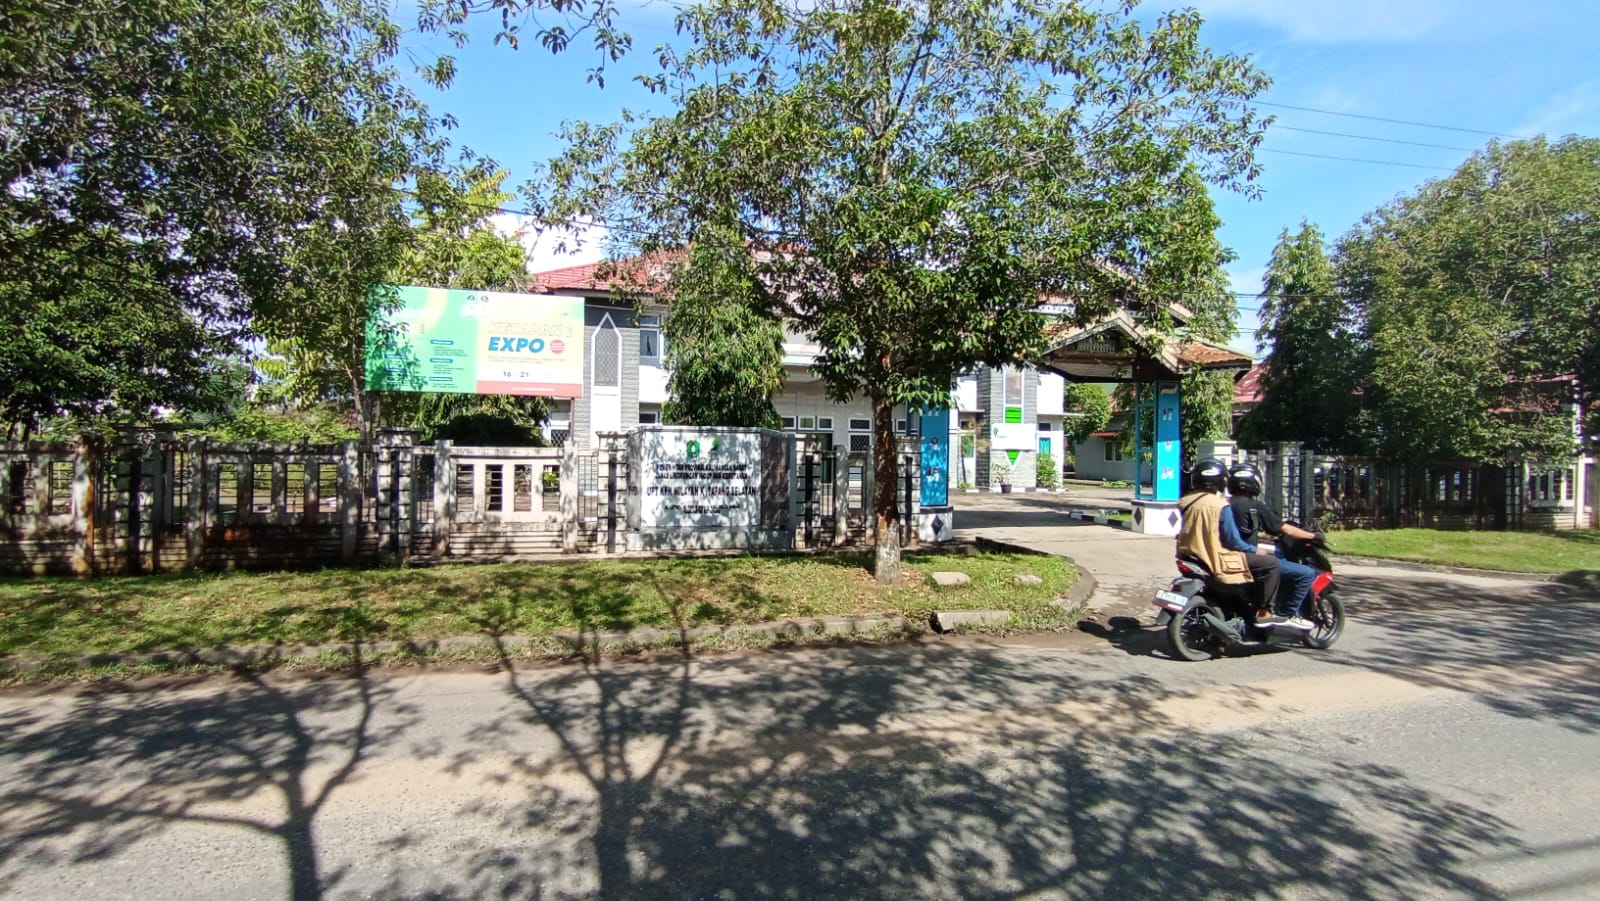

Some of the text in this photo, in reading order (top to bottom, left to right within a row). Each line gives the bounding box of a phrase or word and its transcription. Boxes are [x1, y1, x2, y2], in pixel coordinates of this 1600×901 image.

[488, 336, 545, 353] EXPO
[1163, 407, 1174, 421] 17
[647, 486, 658, 496] UPT
